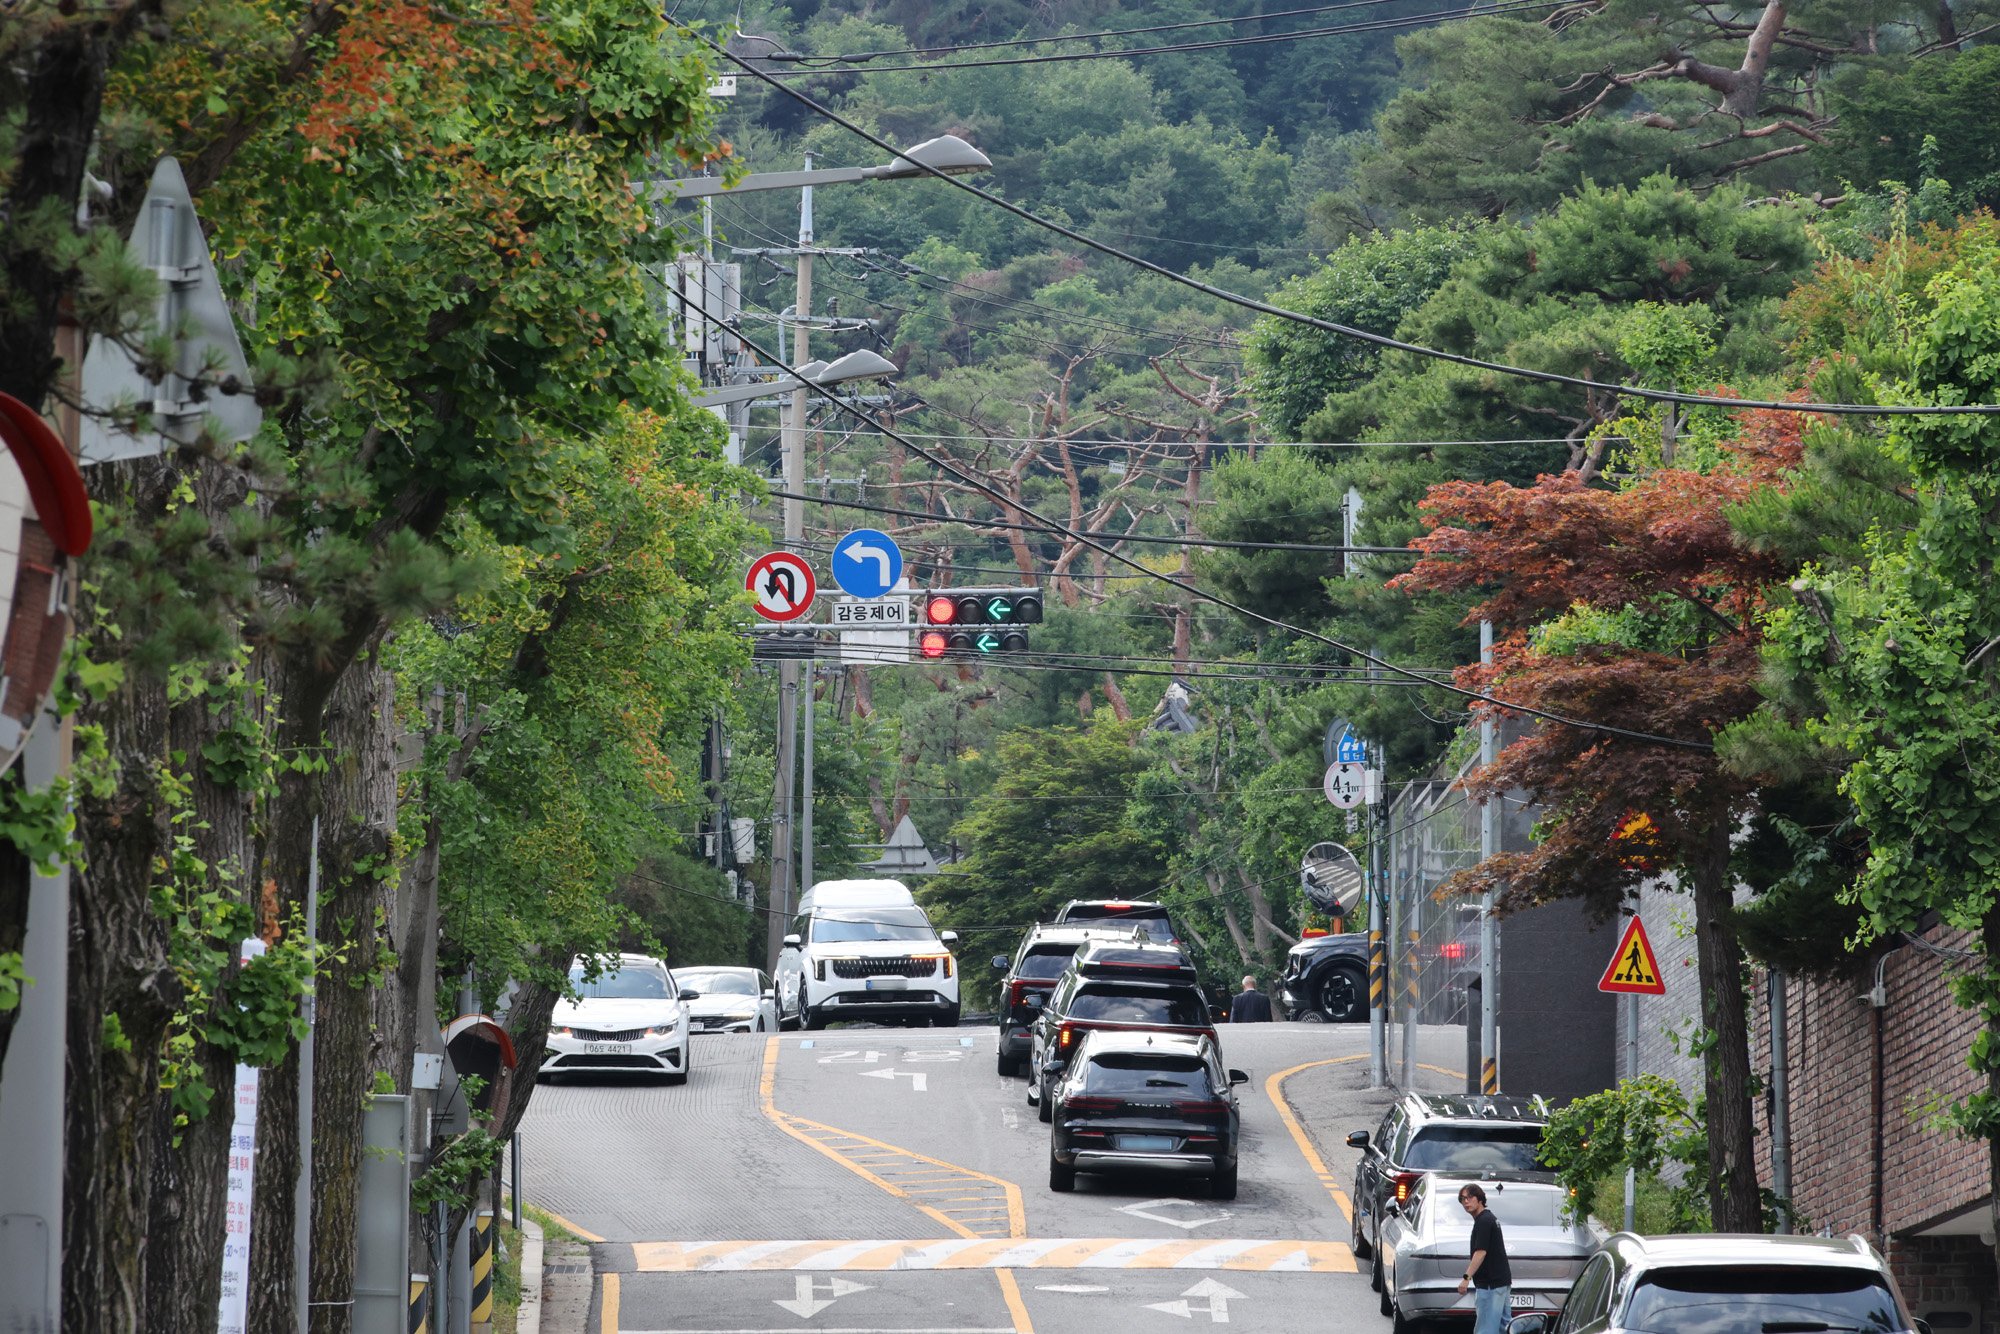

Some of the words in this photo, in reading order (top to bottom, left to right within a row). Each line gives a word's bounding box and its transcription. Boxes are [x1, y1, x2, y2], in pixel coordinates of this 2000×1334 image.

[837, 605, 902, 622] 감응제어
[1332, 775, 1360, 794] 4.1m
[607, 1045, 626, 1053] 4421
